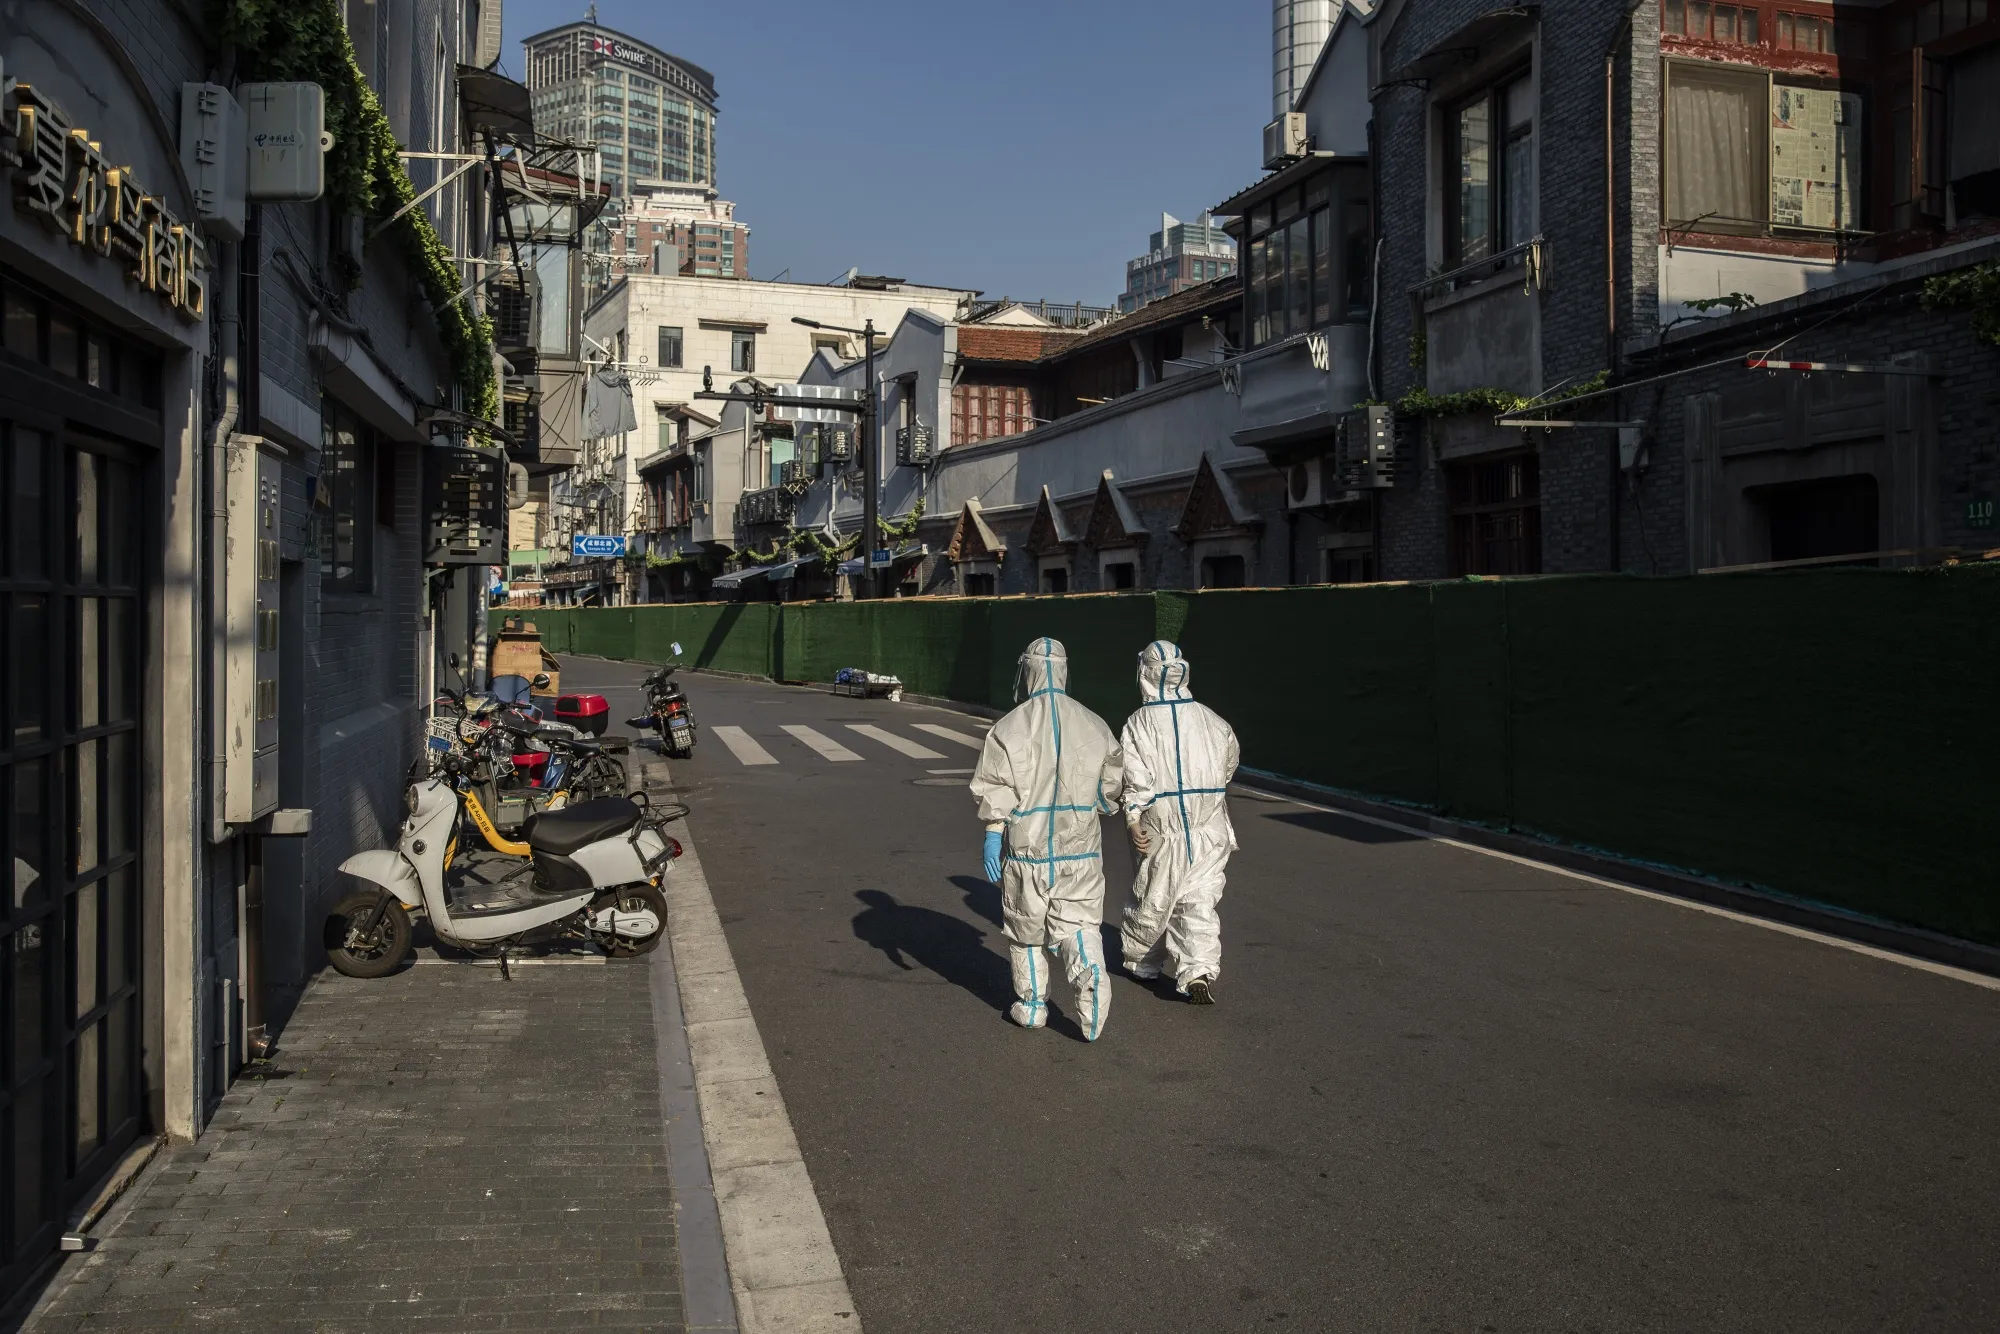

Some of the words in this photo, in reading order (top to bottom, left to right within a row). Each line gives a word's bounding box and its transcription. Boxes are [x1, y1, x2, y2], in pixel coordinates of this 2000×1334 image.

[614, 45, 646, 64] SWIRE
[1968, 501, 1993, 519] 110
[587, 539, 612, 547] 成都北路
